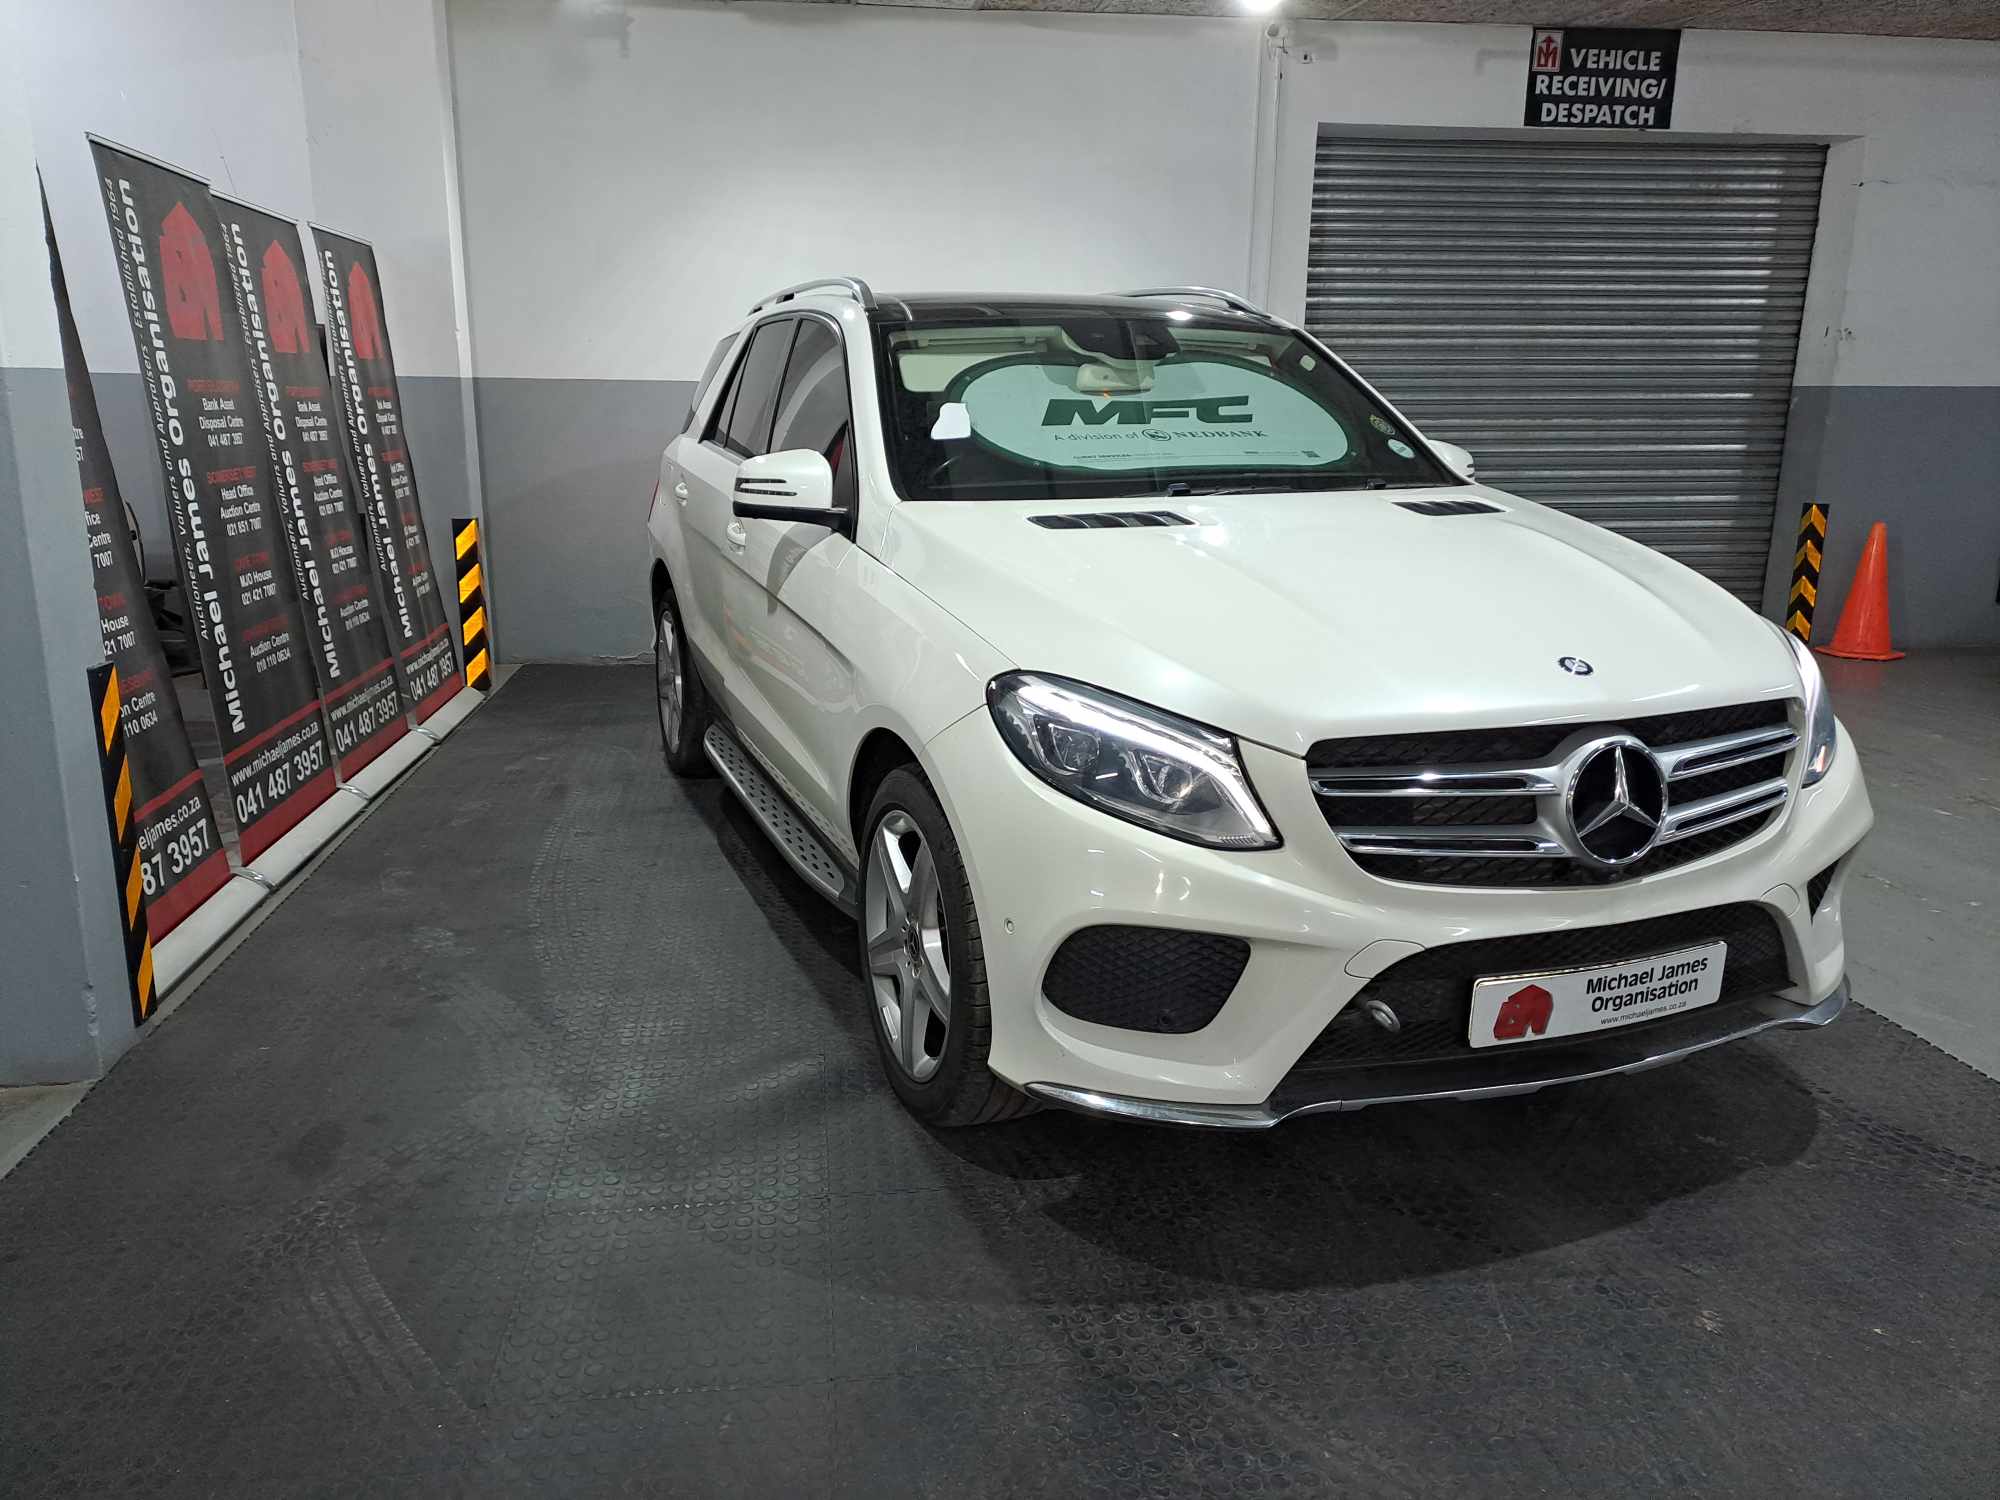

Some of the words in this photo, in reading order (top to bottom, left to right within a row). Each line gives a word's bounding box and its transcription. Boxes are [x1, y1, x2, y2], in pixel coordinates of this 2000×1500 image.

[1570, 48, 1661, 72] VEHICLE
[1535, 74, 1668, 99] RECEIVING/
[1540, 102, 1655, 126] DESPATCH
[116, 226, 144, 329] Established
[118, 178, 184, 446] Organisation
[231, 223, 286, 440] Organisation
[324, 249, 368, 435] Organisation
[140, 345, 167, 434] Appraisers
[160, 438, 174, 471] and
[266, 434, 279, 461] and
[1174, 429, 1268, 439] NEDBANK
[169, 475, 187, 536] Valuers
[281, 450, 312, 551] James
[363, 442, 390, 529] James
[178, 458, 214, 580] James
[220, 505, 244, 520] Auction
[226, 522, 238, 537] 021
[94, 550, 114, 569] 7007
[253, 569, 272, 583] House
[382, 536, 413, 638] Michael
[101, 615, 130, 634] House
[118, 631, 137, 649] 7007
[304, 559, 341, 679] Michael
[203, 590, 246, 734] Michael
[131, 690, 157, 712] Centre
[409, 674, 428, 701] 041
[124, 716, 140, 738] 110
[140, 708, 159, 731] 0634
[335, 723, 358, 753] 041
[358, 706, 376, 737] 487
[375, 690, 399, 724] 3957
[231, 721, 319, 787] www.michaeljames.co.za
[236, 782, 265, 824] 041
[268, 762, 292, 799] 487
[293, 739, 324, 781] 3957
[139, 796, 201, 850] eljames.co.za
[141, 852, 165, 896] 87
[167, 818, 209, 874] 3957
[1586, 967, 1654, 995] Michael
[1658, 957, 1708, 981] James
[1591, 978, 1698, 1013] Organisation
